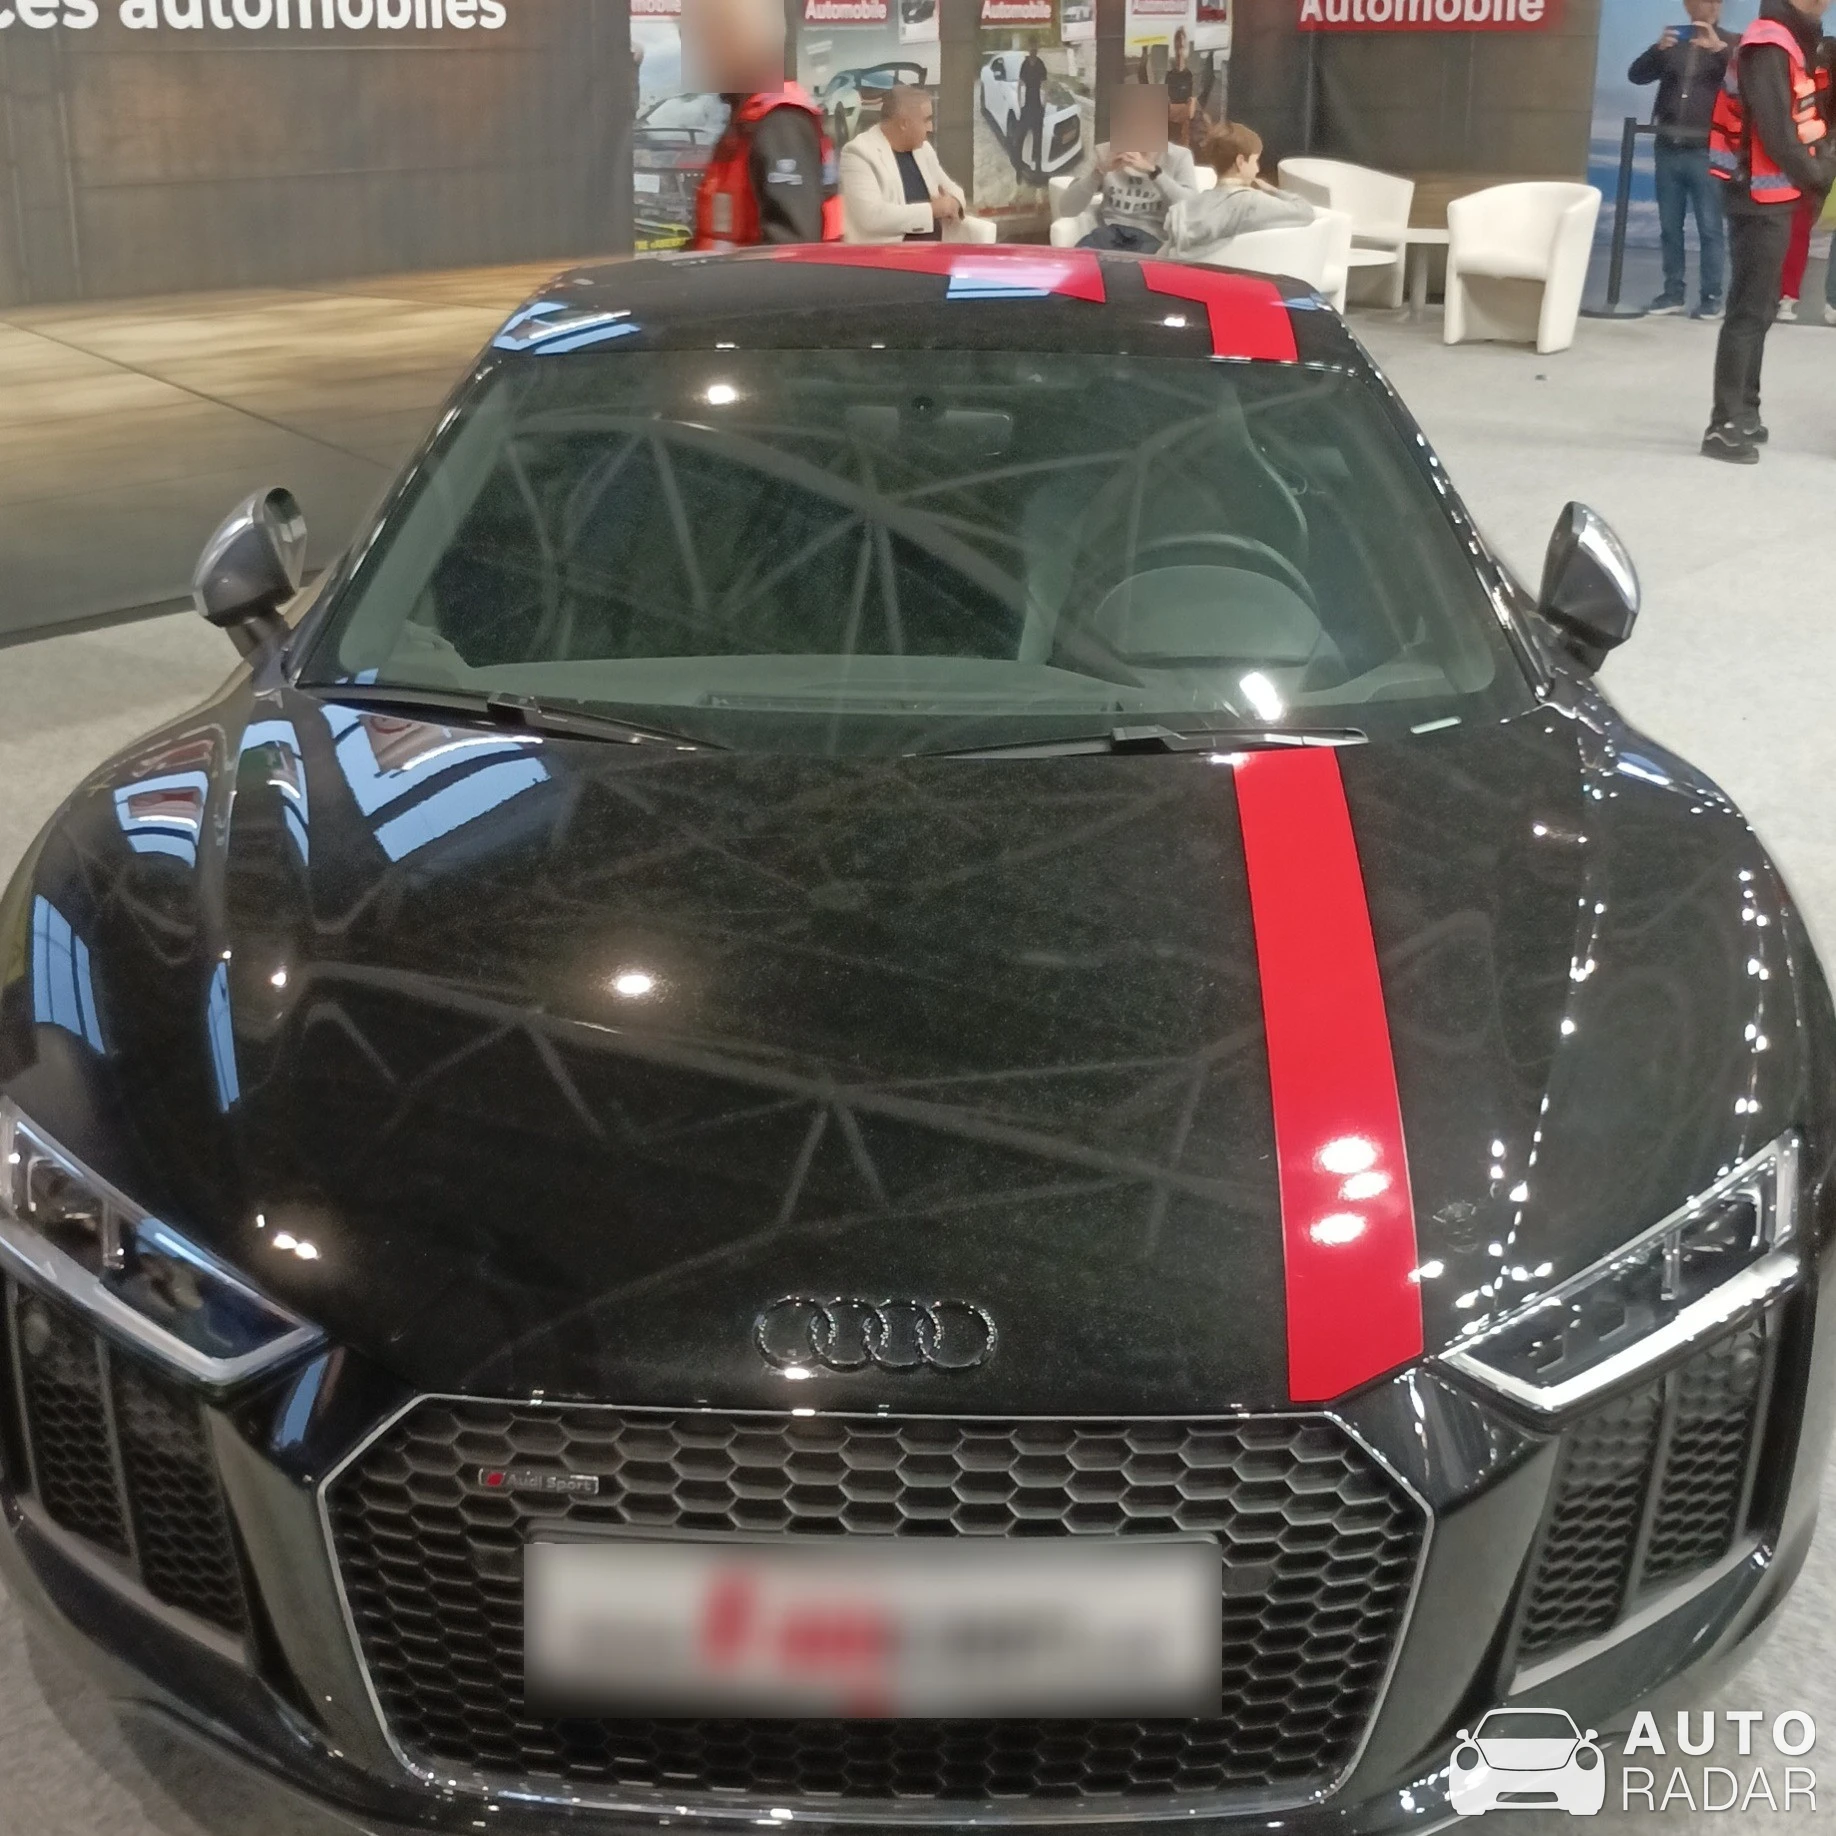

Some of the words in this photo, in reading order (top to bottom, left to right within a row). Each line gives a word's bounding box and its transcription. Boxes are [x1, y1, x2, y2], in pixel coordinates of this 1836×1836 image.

[119, 0, 507, 29] automobiles
[1300, 0, 1545, 22] Automobile
[546, 1476, 592, 1492] Sport
